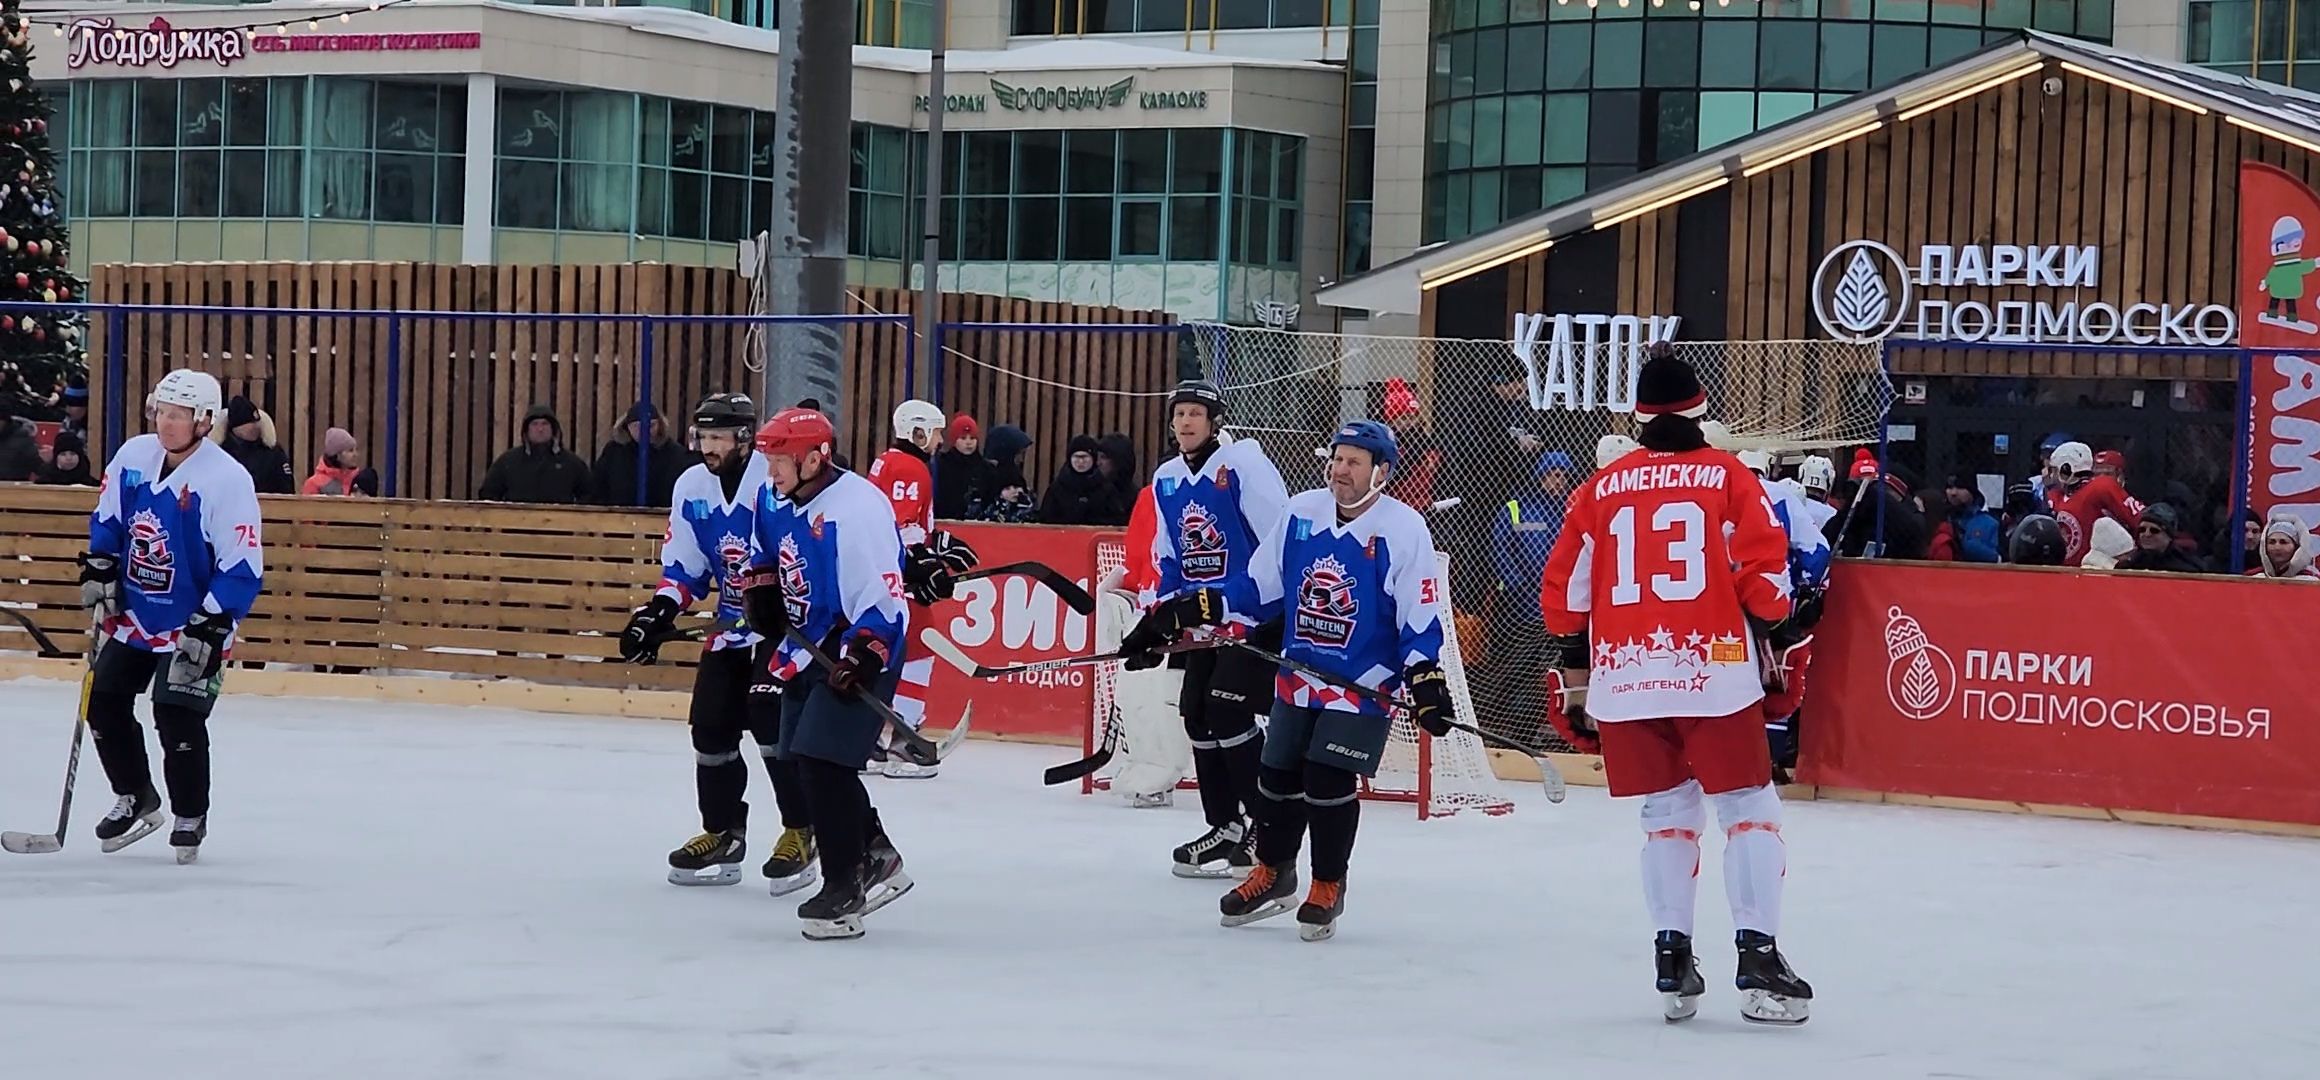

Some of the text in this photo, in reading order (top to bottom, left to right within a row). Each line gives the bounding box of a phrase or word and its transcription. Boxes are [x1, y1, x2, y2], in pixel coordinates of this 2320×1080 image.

[68, 17, 242, 68] Подружка
[915, 95, 986, 112] РЕОРАН
[1139, 91, 1207, 109] КАРАОКЕ
[1920, 245, 2099, 287] ПАРКИ
[1917, 300, 2238, 347] ПОДМОСКО
[892, 480, 919, 501] 64
[1595, 463, 1727, 501] КАМЕНСКИЙ
[1609, 501, 1707, 606] 13
[1611, 679, 1687, 694] ПАРК ЛЕГЕНД
[1965, 649, 2093, 687] ПАРКИ
[1210, 689, 1247, 702] CCM
[1962, 688, 2271, 740] ПОДМОСКОВЬЯ
[1325, 742, 1370, 761] BAUER
